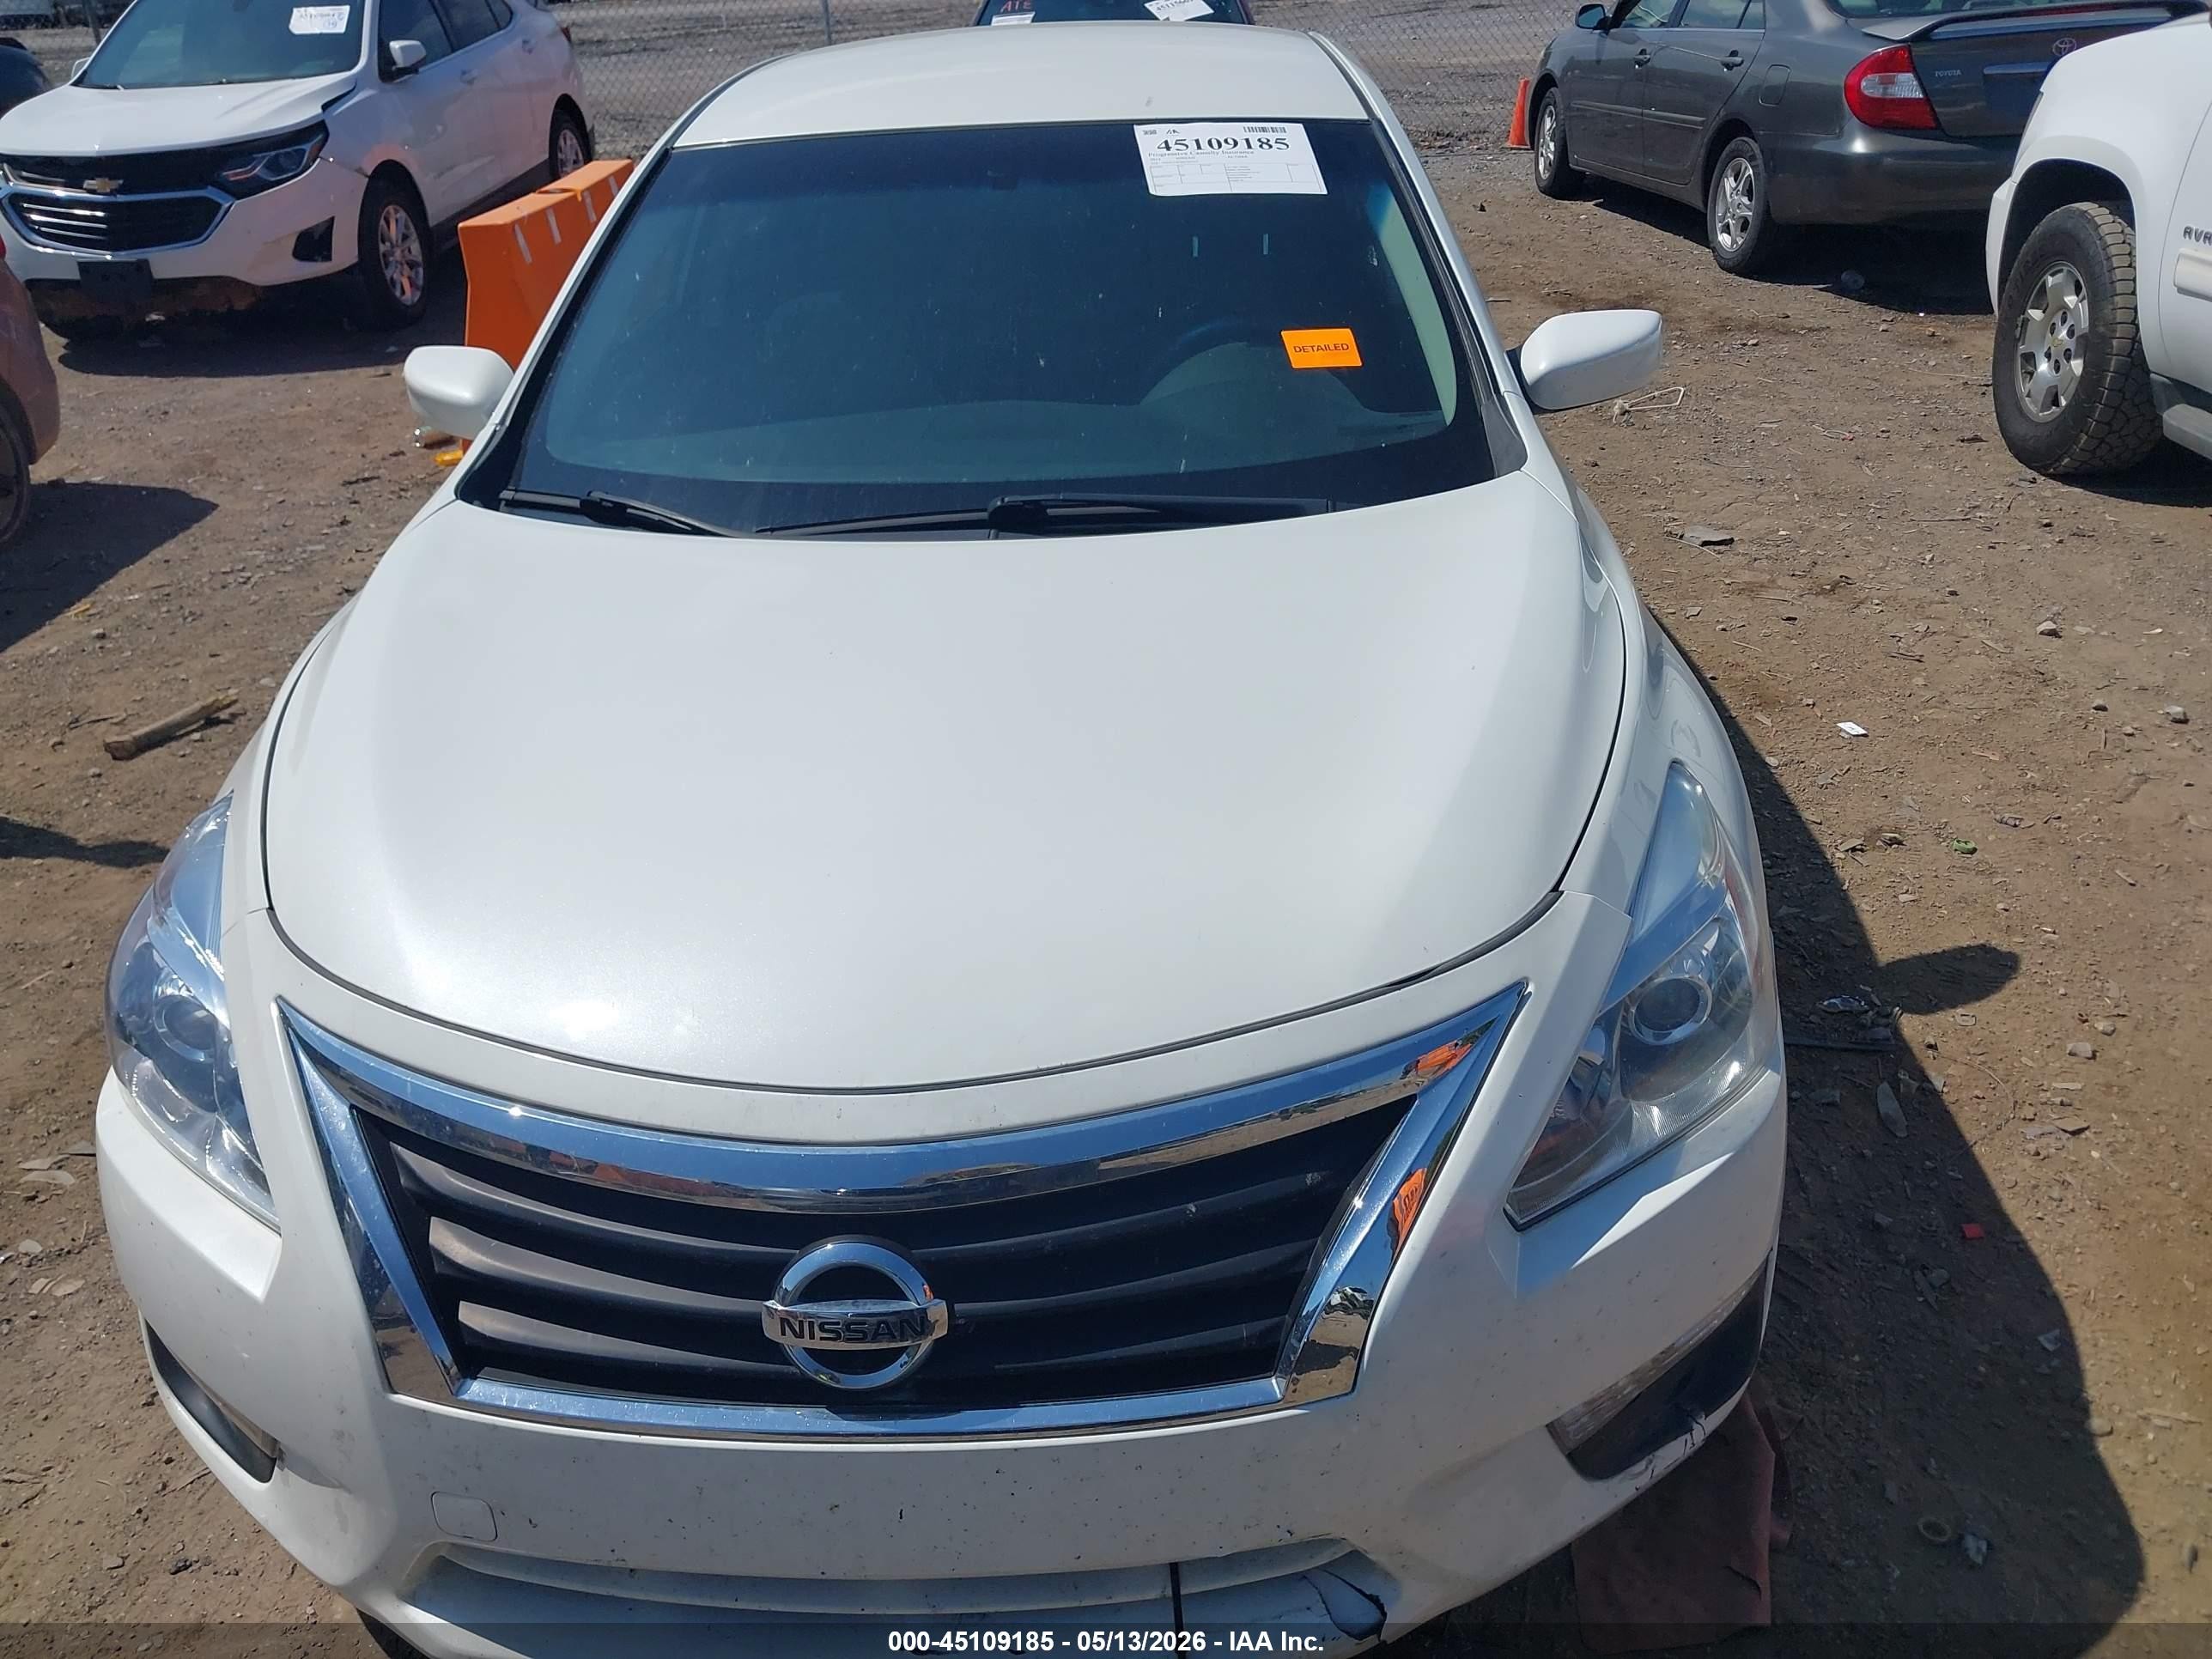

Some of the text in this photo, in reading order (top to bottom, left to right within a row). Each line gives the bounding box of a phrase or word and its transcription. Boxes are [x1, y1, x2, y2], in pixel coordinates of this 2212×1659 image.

[1935, 69, 1962, 77] TOYOTA
[1157, 137, 1290, 151] 45109185
[1293, 343, 1350, 353] DETAILED
[779, 1315, 927, 1343] NISSAN
